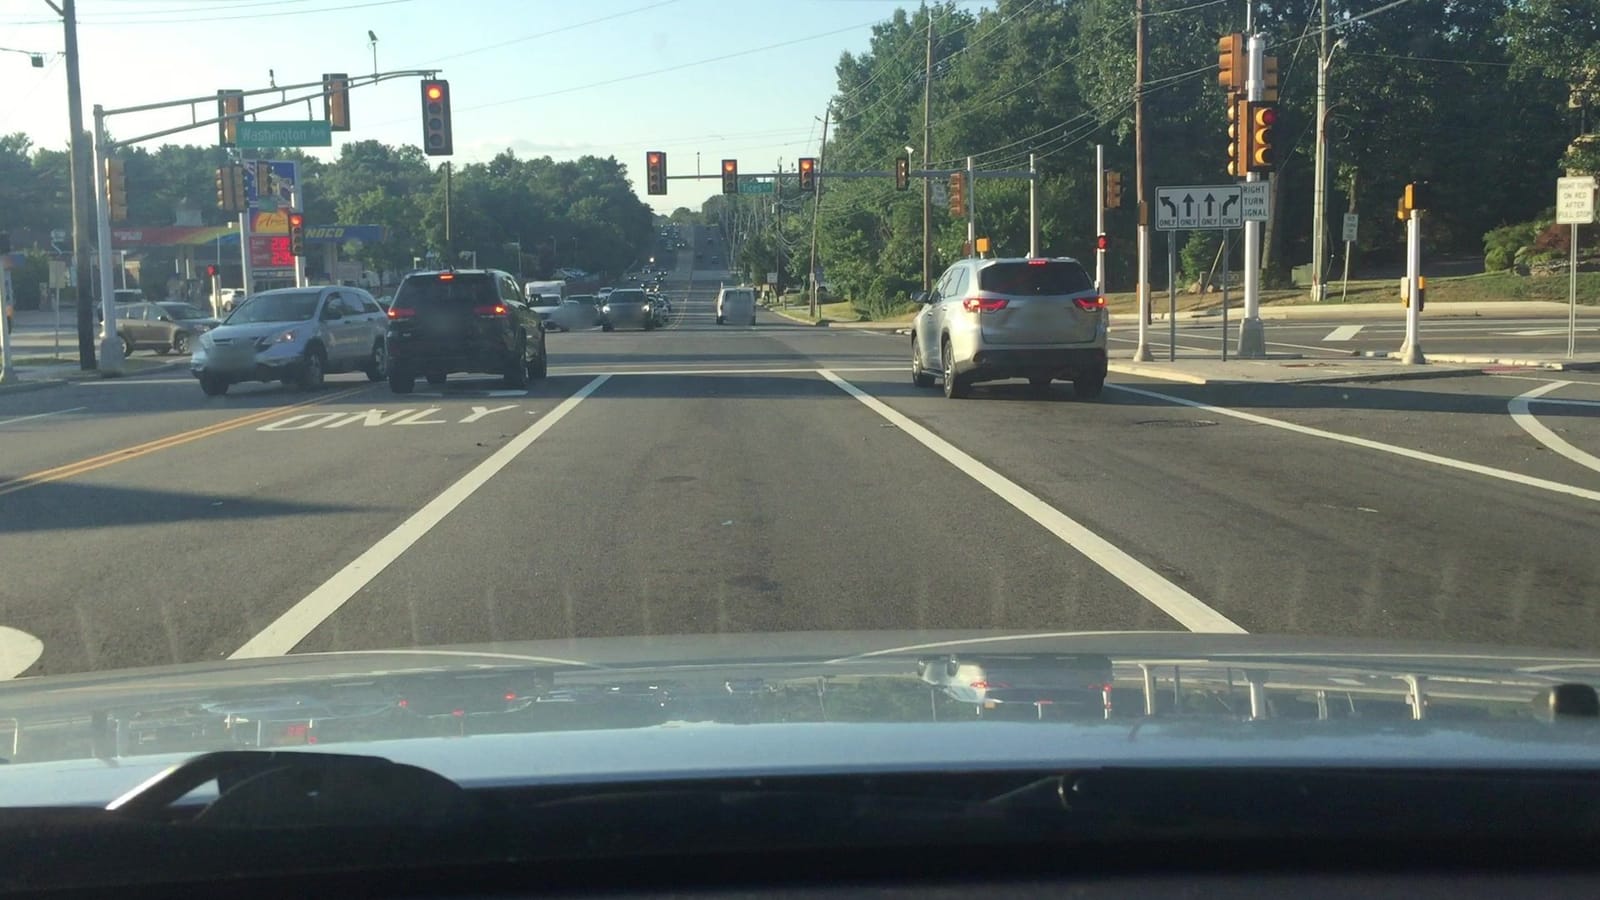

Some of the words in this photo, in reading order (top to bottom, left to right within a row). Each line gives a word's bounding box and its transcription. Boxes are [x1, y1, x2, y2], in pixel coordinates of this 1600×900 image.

[241, 127, 307, 144] Washington
[1243, 185, 1265, 193] RIGHT
[1243, 197, 1264, 205] TURN
[256, 404, 520, 431] ONLY
